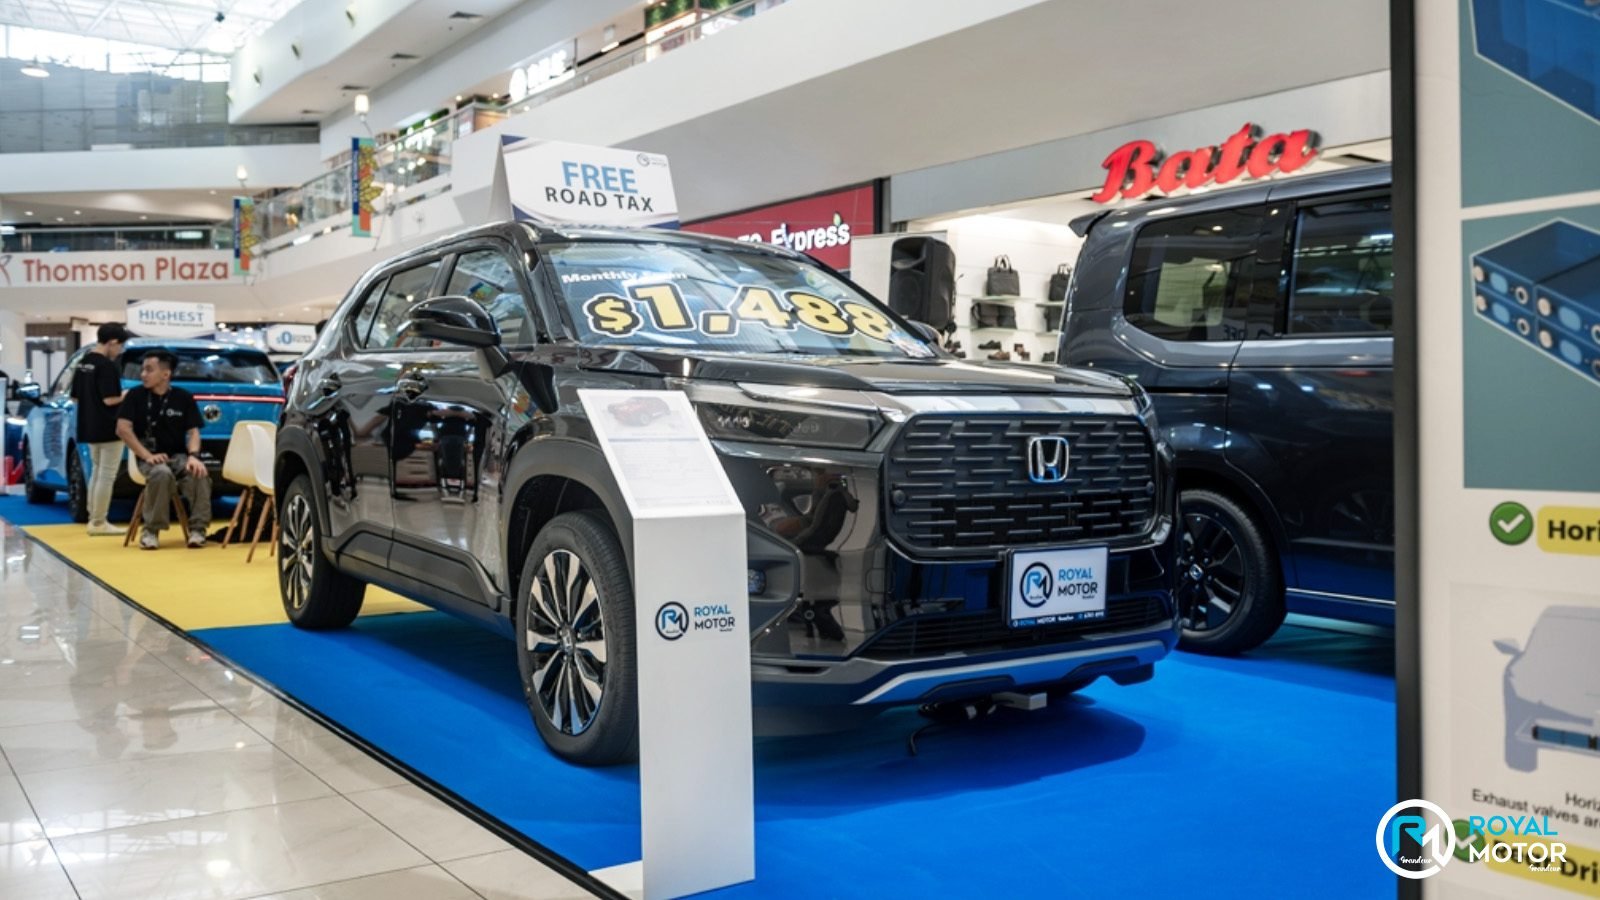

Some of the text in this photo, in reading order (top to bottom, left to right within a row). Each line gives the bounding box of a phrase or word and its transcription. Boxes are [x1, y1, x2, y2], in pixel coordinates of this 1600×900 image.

[1092, 122, 1318, 204] Bata
[562, 160, 638, 194] FREE
[545, 186, 654, 213] ROAD TAX
[23, 256, 229, 283] Thomson Plaza
[561, 270, 639, 284] Monthly
[138, 309, 206, 322] HIGHEST
[1058, 567, 1093, 581] ROYAL
[1057, 582, 1098, 597] MOTOR
[694, 604, 731, 616] ROYAL
[694, 616, 735, 630] MOTOR
[1472, 787, 1529, 810] Exhaust
[1560, 856, 1600, 884] Dri
